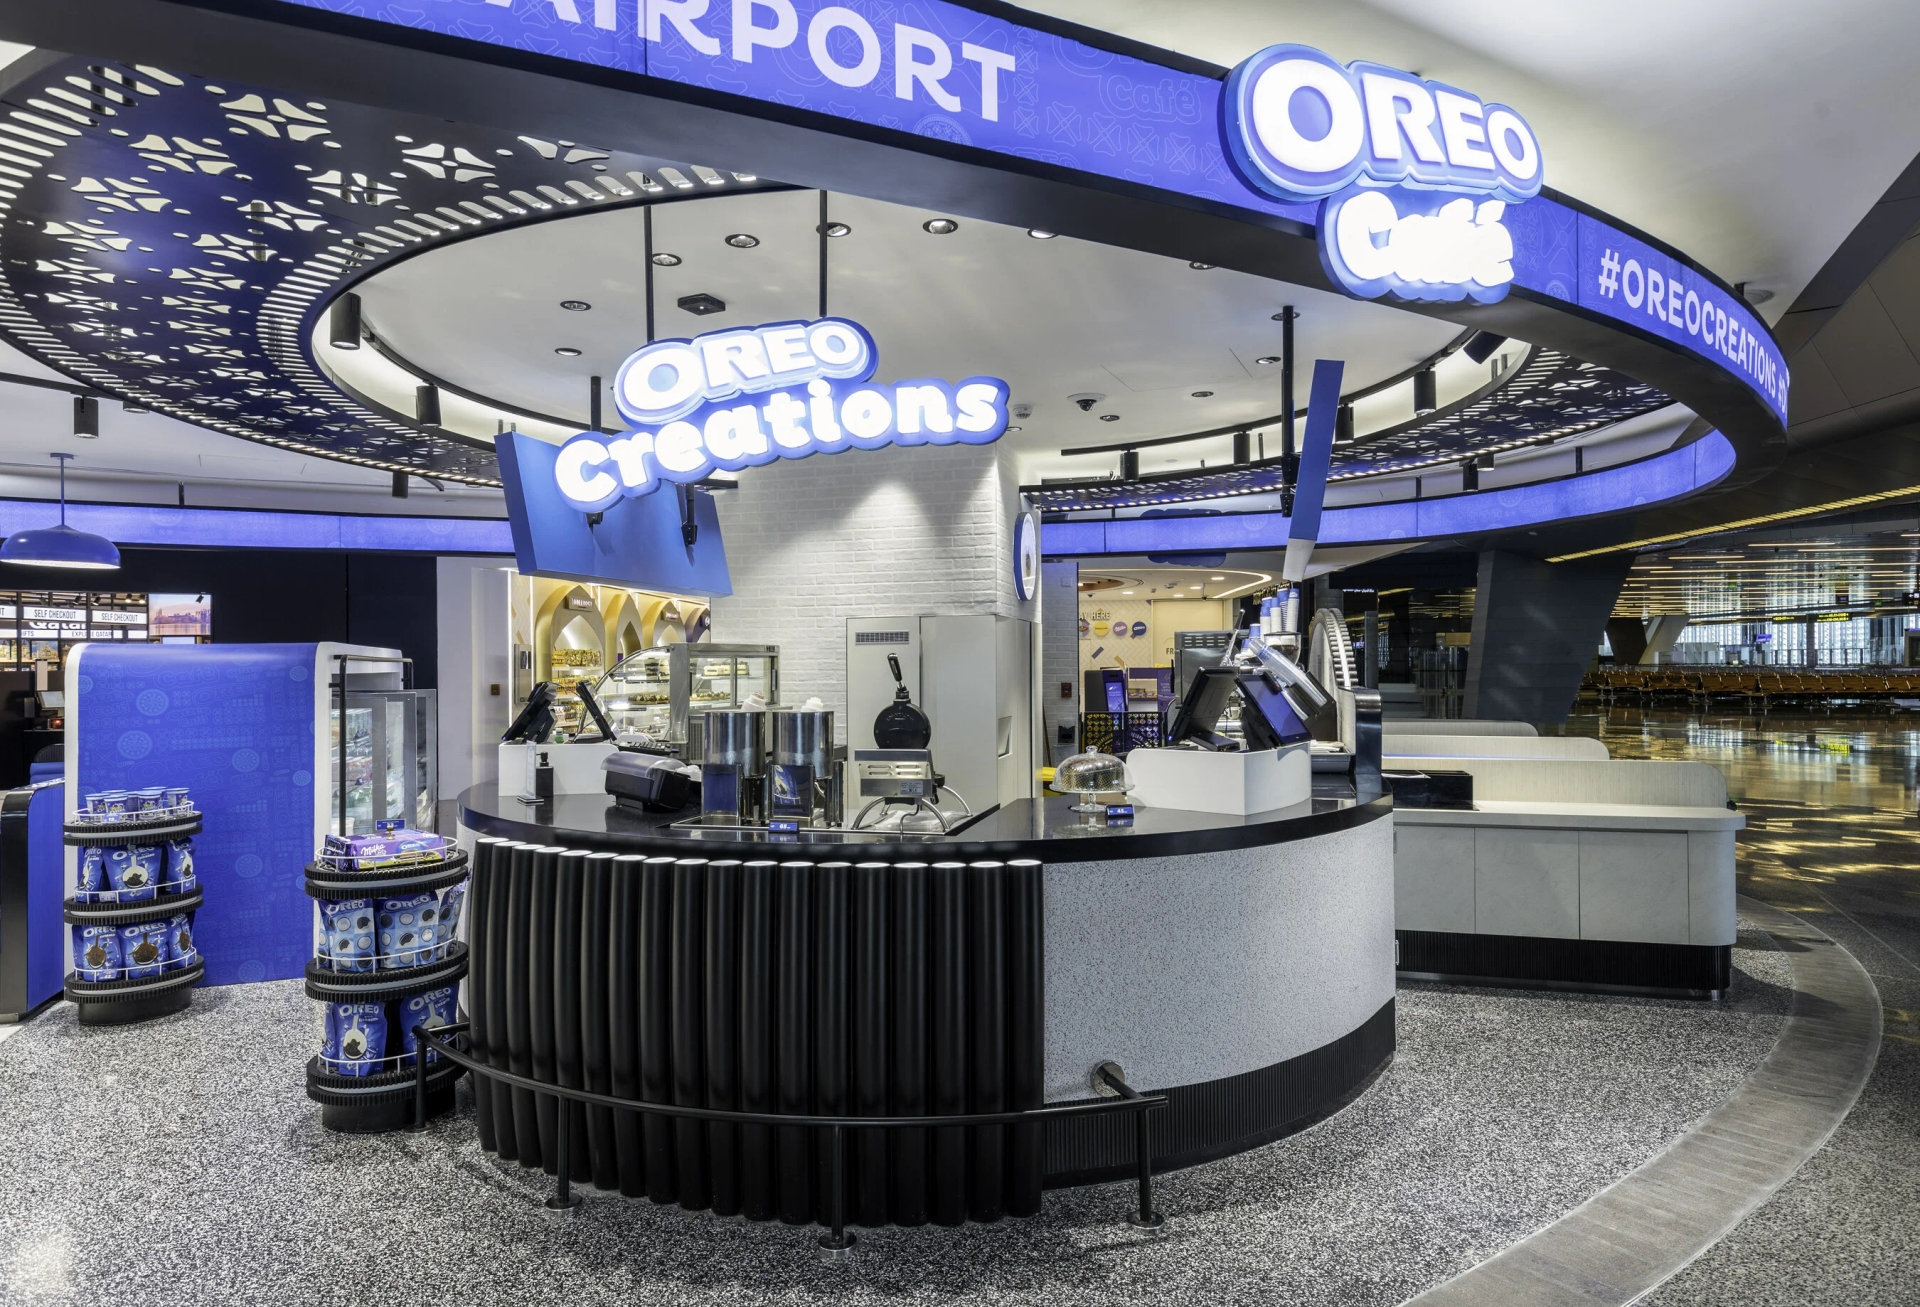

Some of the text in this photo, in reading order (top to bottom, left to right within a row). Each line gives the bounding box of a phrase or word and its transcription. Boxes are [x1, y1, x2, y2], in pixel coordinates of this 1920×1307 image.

[1253, 58, 1538, 180] OREO
[1598, 248, 1776, 399] #OREOCREATIONS
[622, 320, 861, 411] OREO
[554, 378, 1000, 502] Creations
[34, 609, 77, 619] SELF CHECKOUT
[101, 613, 138, 622] SELF CHECKOUT
[1091, 611, 1110, 620] HERE
[361, 844, 386, 856] Milka
[327, 900, 364, 916] OREO
[385, 894, 432, 912] OREO
[124, 922, 166, 938] OREO
[409, 987, 452, 1011] OREO
[340, 1003, 379, 1017] OREO
